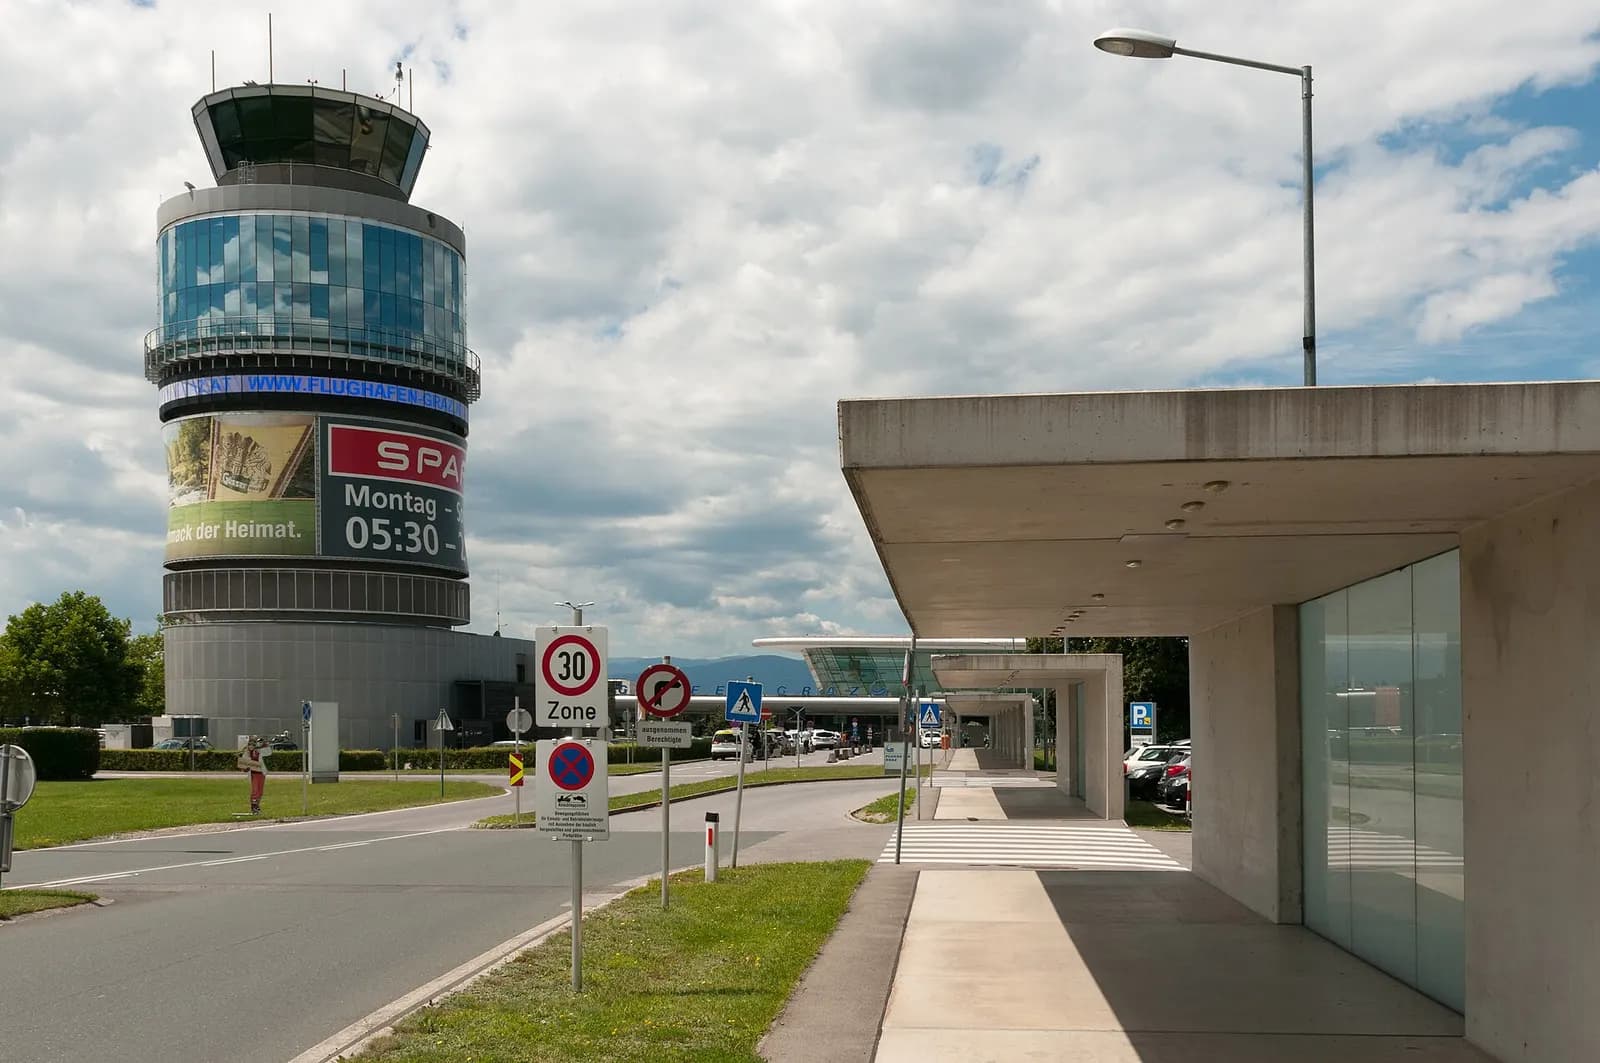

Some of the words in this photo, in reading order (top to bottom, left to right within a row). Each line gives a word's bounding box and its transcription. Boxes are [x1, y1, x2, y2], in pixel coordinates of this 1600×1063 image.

[345, 484, 437, 521] Montag
[196, 522, 220, 540] der
[225, 520, 301, 538] Heimat.
[345, 516, 439, 555] 05:30
[558, 651, 586, 681] 30
[776, 685, 860, 696] GRAZ
[547, 701, 597, 720] Zone
[641, 727, 687, 735] ausgenommen
[646, 735, 682, 744] Berechtigte
